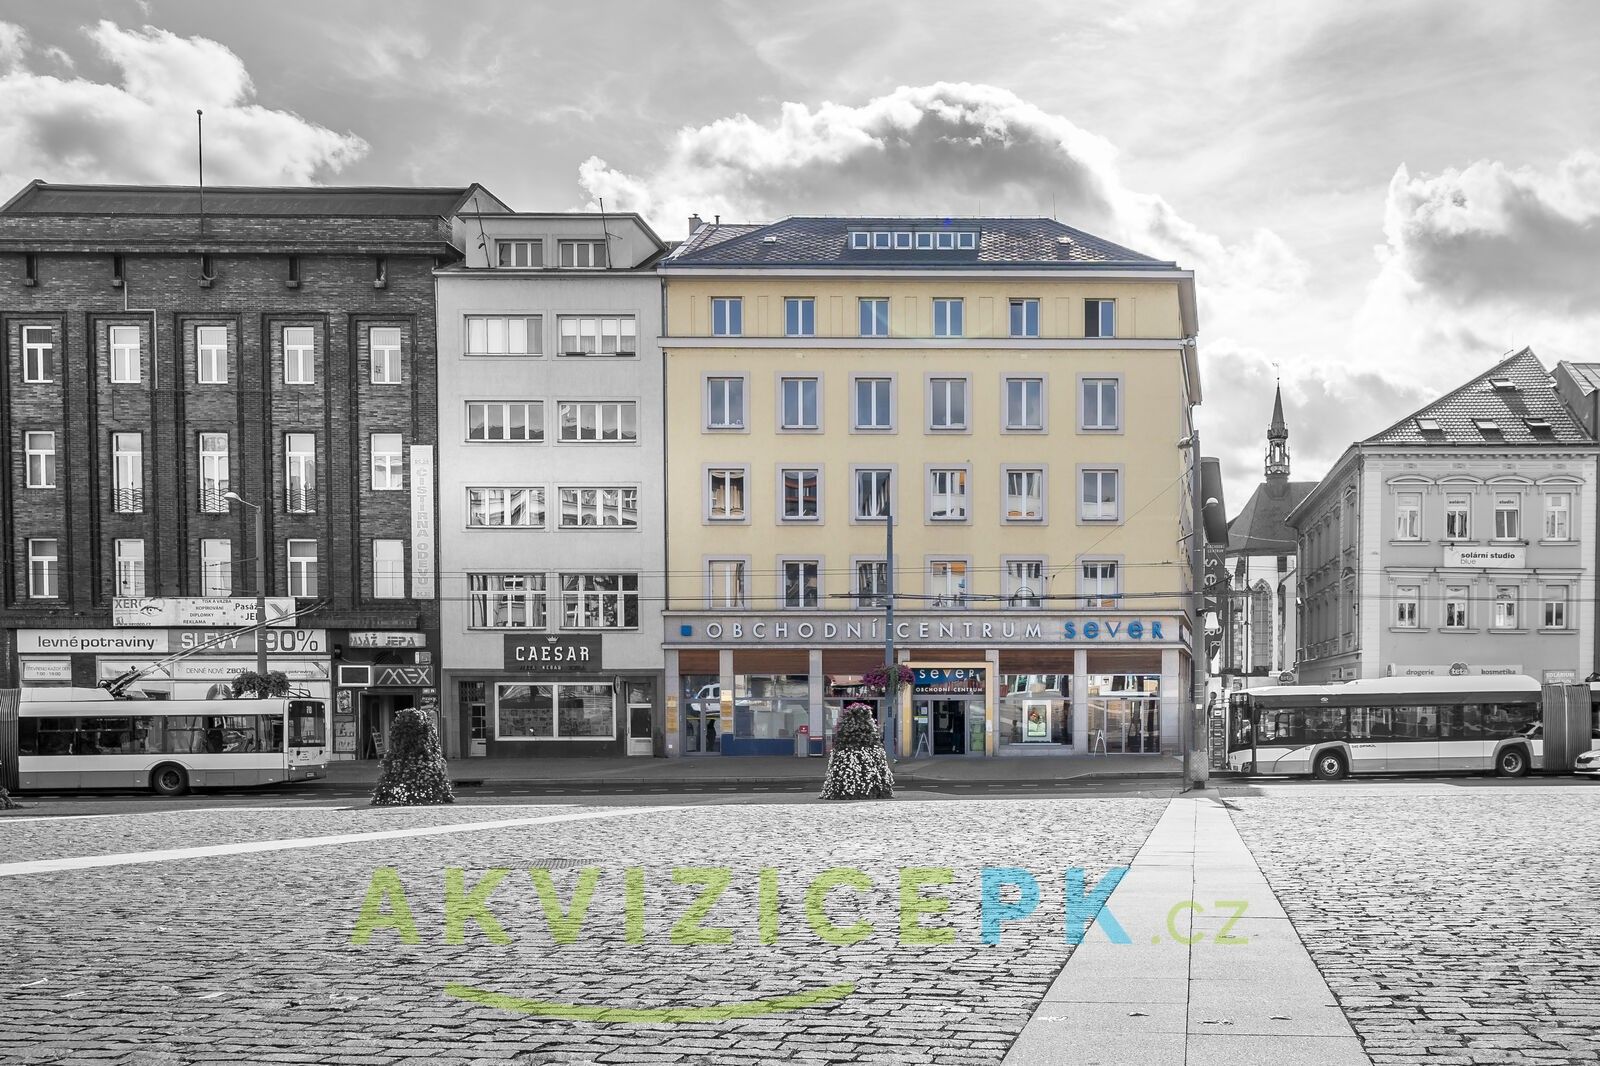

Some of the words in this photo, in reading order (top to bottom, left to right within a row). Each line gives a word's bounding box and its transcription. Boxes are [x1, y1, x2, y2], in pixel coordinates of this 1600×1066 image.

[245, 612, 258, 621] JE
[706, 618, 880, 639] OBCHODNÍ
[896, 621, 1042, 639] CENTRUM
[38, 635, 79, 648] levné
[80, 636, 155, 650] potraviny
[181, 632, 241, 650] SLEVY
[266, 630, 318, 651] 90%
[386, 636, 416, 646] JEPA
[515, 646, 589, 661] CAESAR
